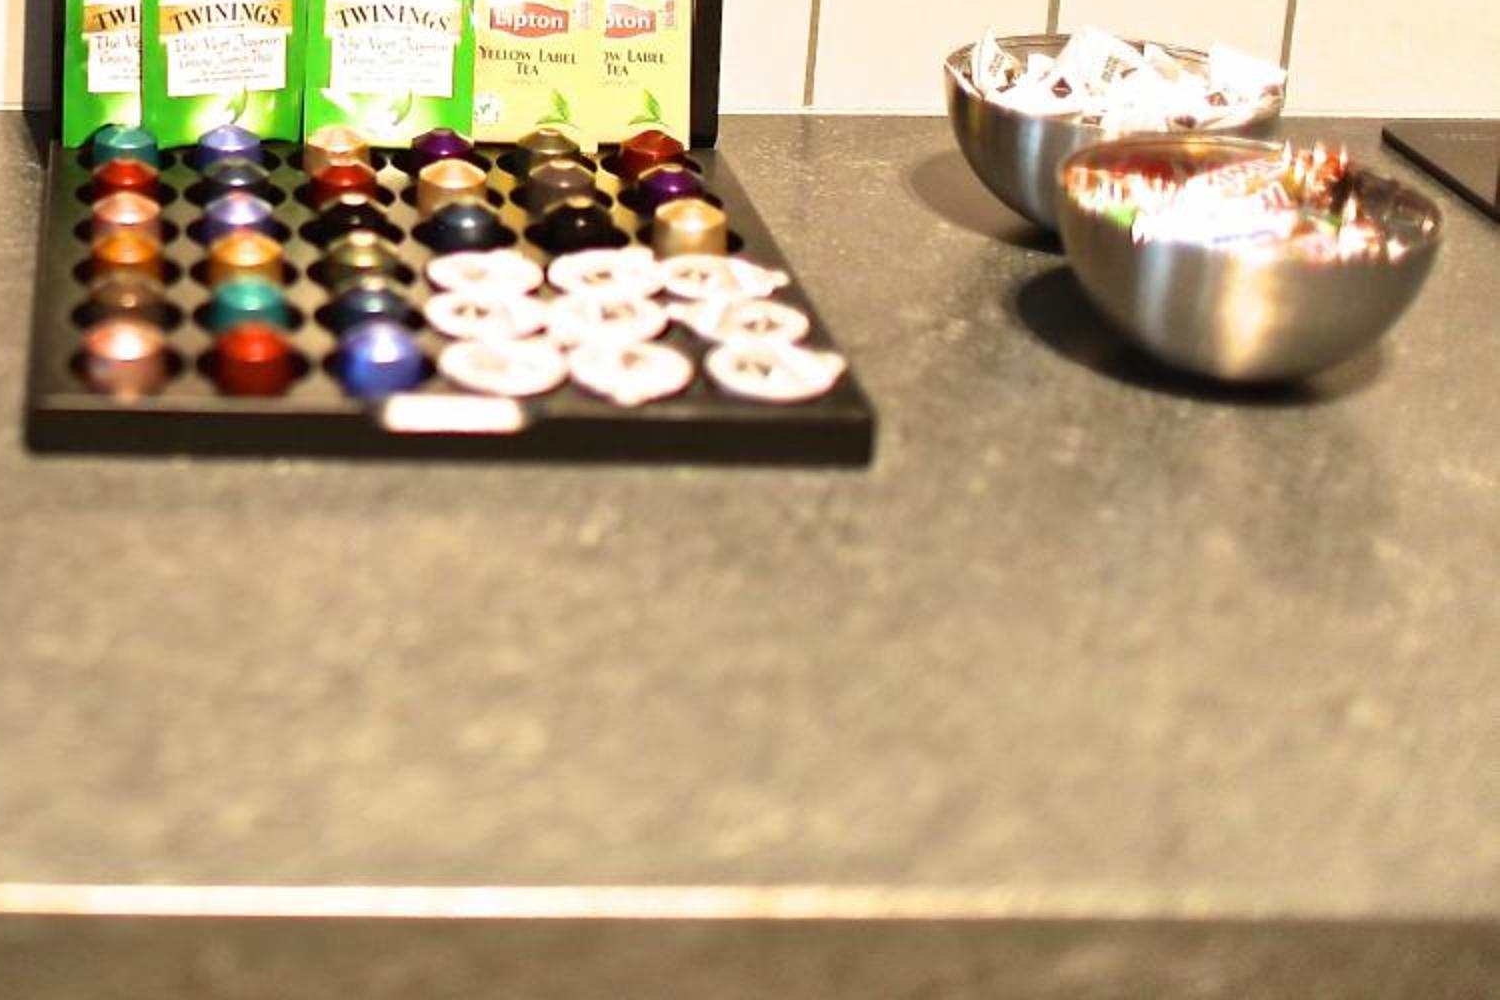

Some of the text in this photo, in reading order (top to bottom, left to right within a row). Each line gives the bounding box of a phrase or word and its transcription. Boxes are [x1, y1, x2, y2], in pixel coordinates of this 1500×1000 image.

[169, 2, 281, 32] TWININGS
[335, 3, 451, 31] TWININGS
[494, 9, 564, 32] Lipton
[478, 45, 578, 65] YELLOW LABEL
[627, 49, 665, 64] LABEL
[516, 62, 539, 76] TEA
[606, 63, 630, 76] TEA
